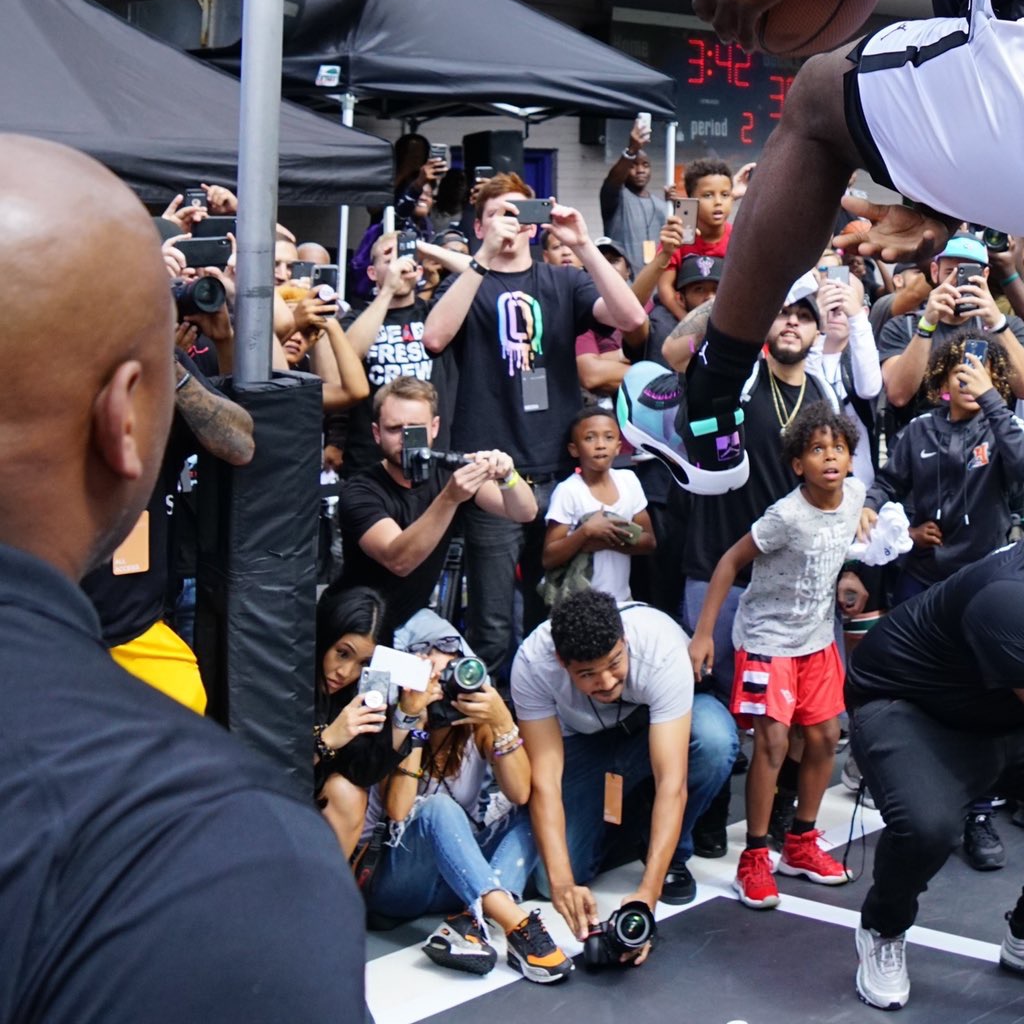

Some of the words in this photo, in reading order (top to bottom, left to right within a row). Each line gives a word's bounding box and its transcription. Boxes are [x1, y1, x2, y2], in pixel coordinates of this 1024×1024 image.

[688, 39, 752, 87] 3:42
[690, 117, 728, 141] period
[740, 112, 755, 144] 2
[368, 359, 433, 385] CREW
